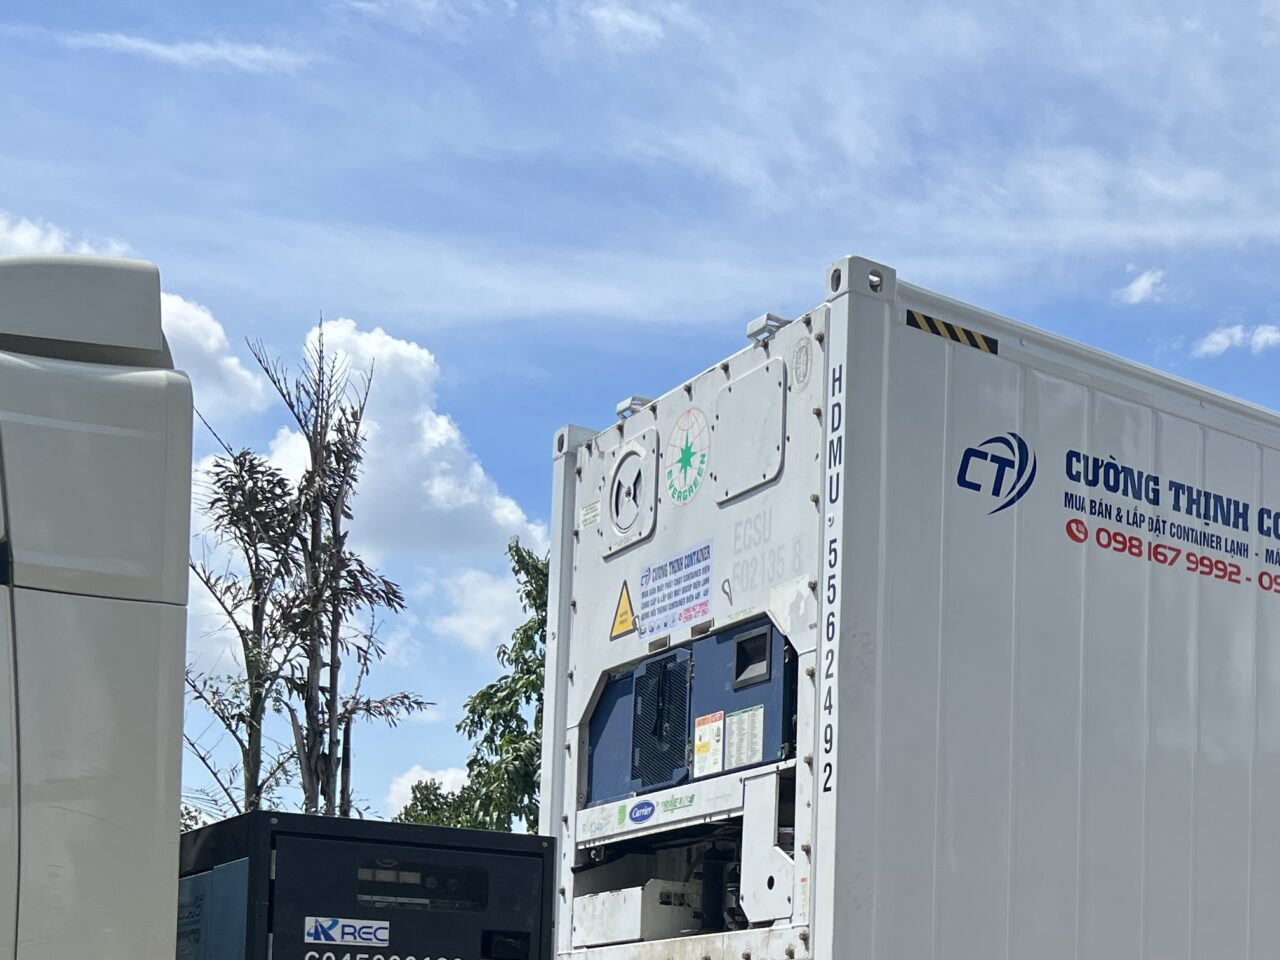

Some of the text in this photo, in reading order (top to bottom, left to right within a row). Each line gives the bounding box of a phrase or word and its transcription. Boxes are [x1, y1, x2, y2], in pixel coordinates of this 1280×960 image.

[667, 453, 706, 501] EVERGREEN
[1066, 450, 1160, 506] CƯỜNG
[1168, 480, 1250, 532] THỊNH
[1064, 491, 1087, 514] MUA
[1089, 498, 1112, 521] BÁN
[1115, 507, 1123, 524] &
[1126, 505, 1146, 529] LẮP
[1169, 522, 1222, 551] CONTAINER
[1224, 537, 1249, 559] LẠNH
[1095, 527, 1143, 558] 098
[1147, 541, 1182, 567] 167
[1185, 552, 1241, 585] 9992
[822, 364, 843, 793] HDMU 5562492
[631, 805, 653, 819] Carrier
